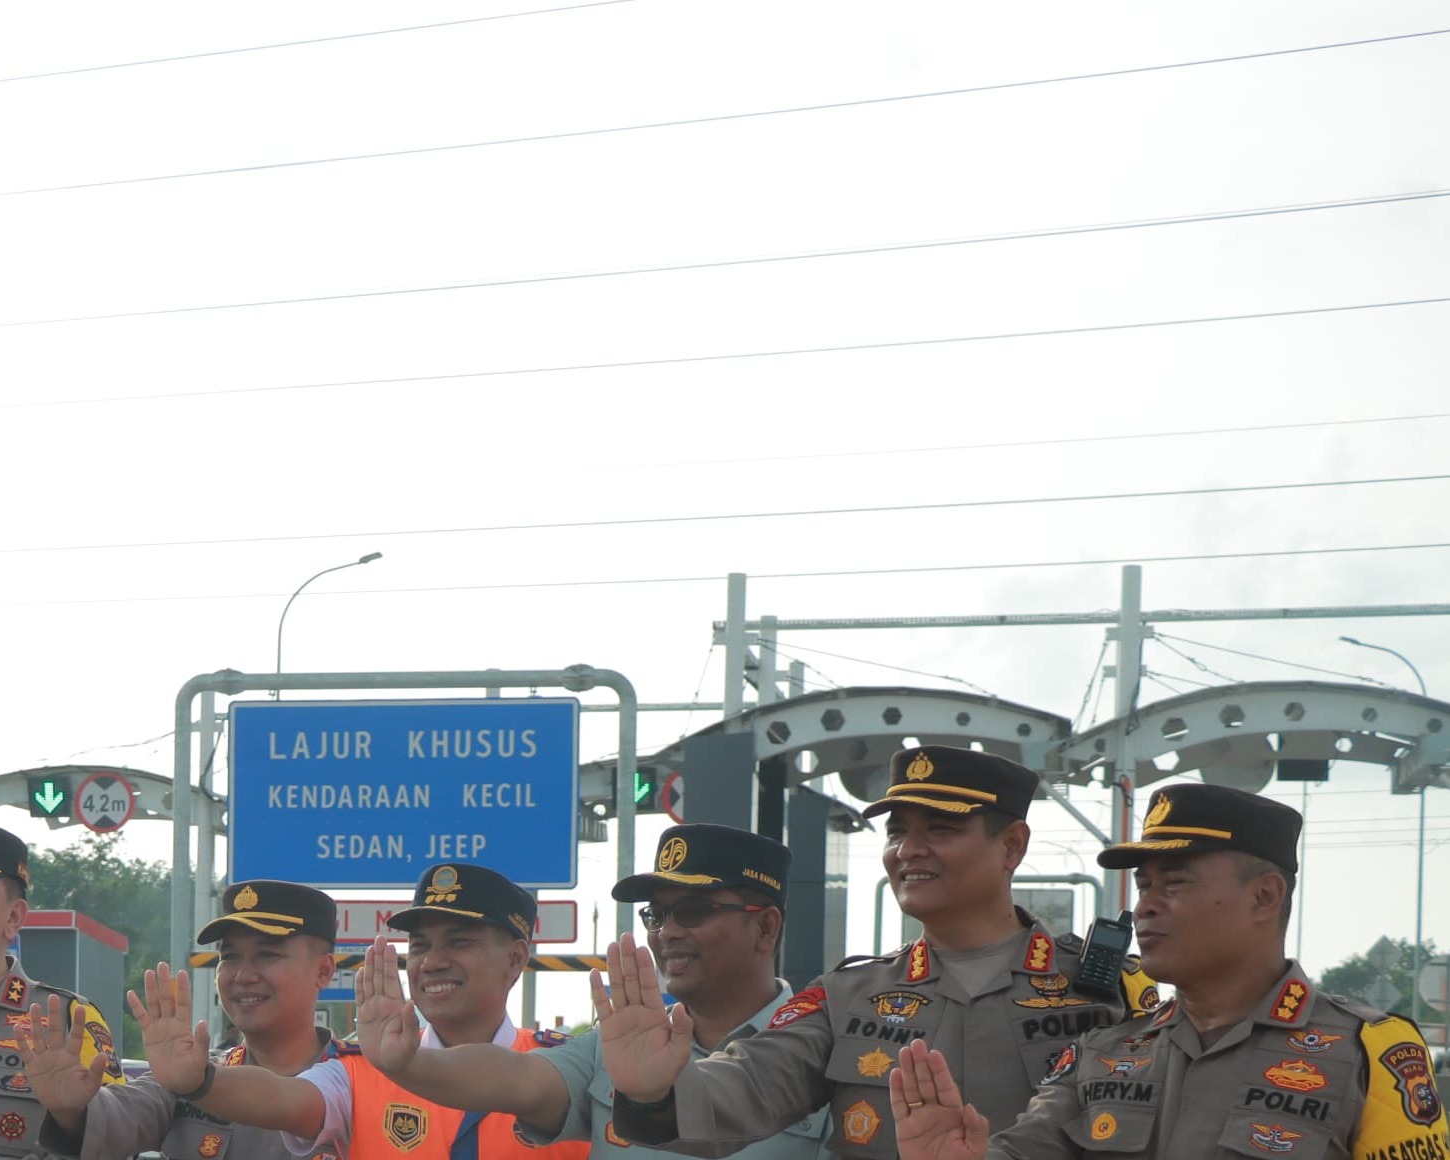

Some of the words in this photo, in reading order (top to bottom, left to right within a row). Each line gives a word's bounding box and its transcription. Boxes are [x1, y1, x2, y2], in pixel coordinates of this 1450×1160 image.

[268, 731, 372, 760] LAJUR
[407, 729, 538, 759] KHUSUS
[268, 784, 431, 809] KENDARAAN
[462, 783, 536, 808] KECIL
[316, 834, 413, 863] SEDAN,
[425, 834, 487, 859] JEEP
[1390, 1048, 1424, 1065] POLDA
[1083, 1081, 1153, 1104] HERY.M
[1244, 1087, 1330, 1121] POLRI
